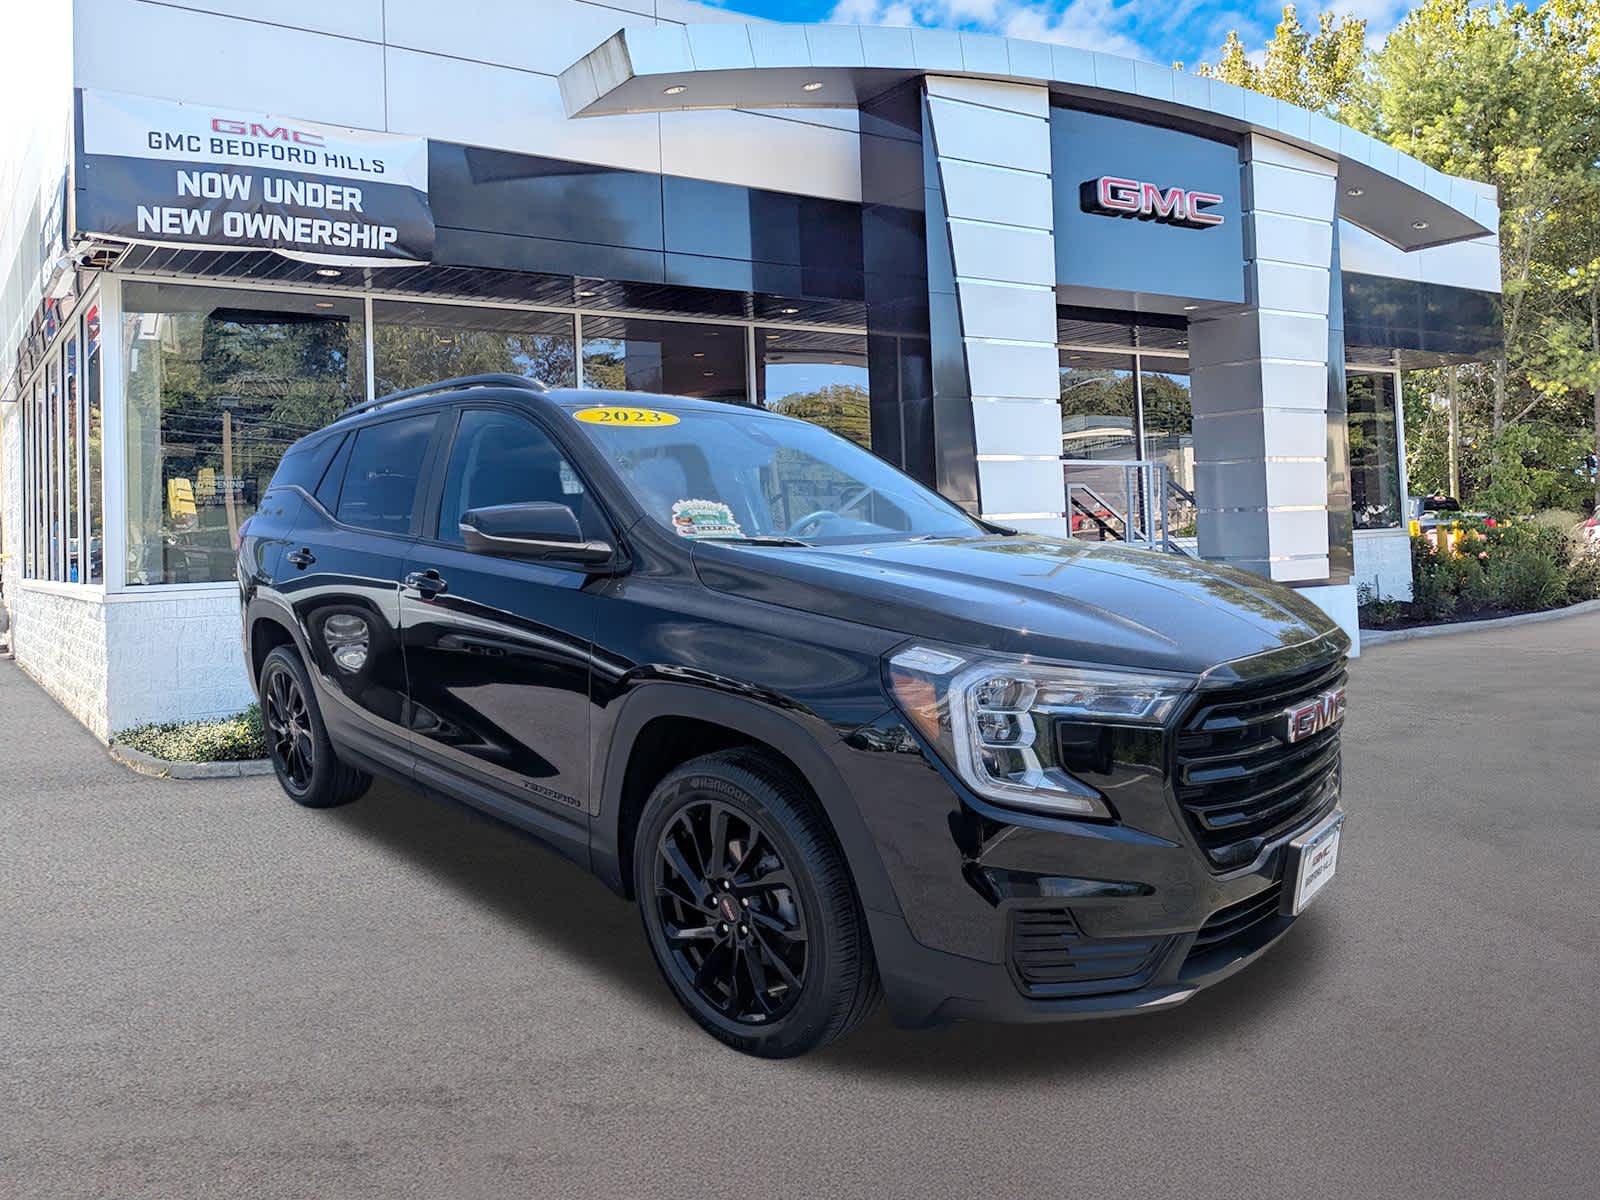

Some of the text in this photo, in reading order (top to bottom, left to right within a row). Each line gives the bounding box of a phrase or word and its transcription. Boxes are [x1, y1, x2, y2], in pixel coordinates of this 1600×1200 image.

[147, 130, 385, 174] GMC BEDFORD HILLS
[210, 118, 326, 148] GMC
[176, 170, 364, 213] NOW UNDER
[1097, 175, 1225, 225] GMC
[136, 205, 399, 250] NEW OWNERSHIP
[599, 410, 663, 423] 2023
